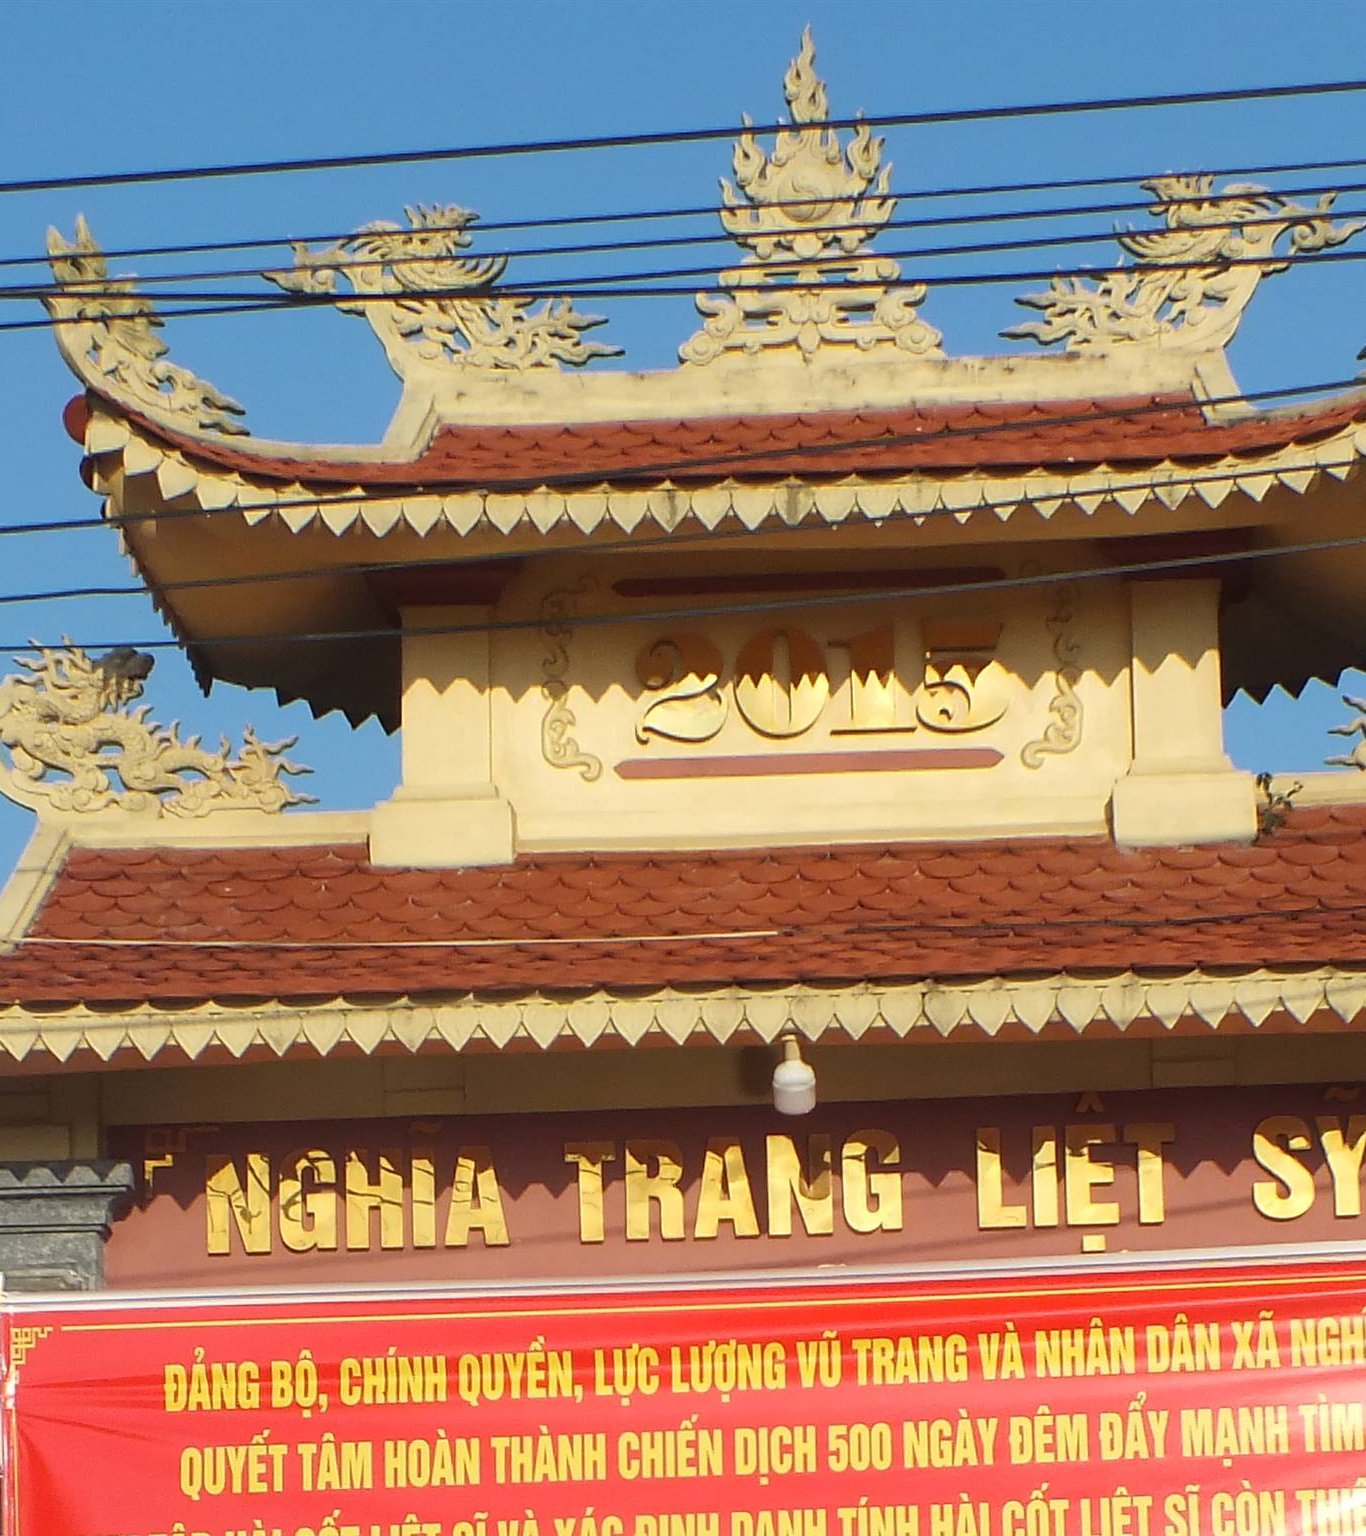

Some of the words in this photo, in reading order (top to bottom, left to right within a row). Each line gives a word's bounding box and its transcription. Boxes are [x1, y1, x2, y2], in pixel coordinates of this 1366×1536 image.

[635, 621, 1012, 745] 2015
[206, 1122, 511, 1255] NGHĨA
[564, 1130, 903, 1244] TRANG
[976, 1092, 1176, 1253] LIỆT
[164, 1347, 259, 1411] ĐẢNG
[272, 1350, 327, 1417] BỘ,
[341, 1347, 446, 1405] CHÍNH
[459, 1336, 583, 1406] QUYỀN,
[595, 1344, 659, 1404] LỰC
[672, 1340, 786, 1403] LƯỢNG
[797, 1331, 841, 1388] VŨ
[853, 1335, 968, 1386] TRANG
[979, 1322, 1025, 1380] VÀ
[1035, 1318, 1136, 1377] NHÂN
[1146, 1314, 1221, 1372] DÂN
[1232, 1310, 1279, 1369] XÃ
[181, 1430, 287, 1500] QUYẾT
[298, 1433, 372, 1491] TÂM
[385, 1429, 480, 1488] HOÀN
[491, 1425, 605, 1483] THÀNH
[619, 1414, 723, 1479] CHIẾN
[735, 1426, 816, 1485] DỊCH
[828, 1423, 892, 1472] 500
[903, 1409, 998, 1468] NGÀY
[1009, 1405, 1089, 1464] ĐÊM
[1099, 1392, 1169, 1460] ĐẨY
[1180, 1406, 1286, 1469] MẠNH
[1298, 1394, 1365, 1454] TÌM
